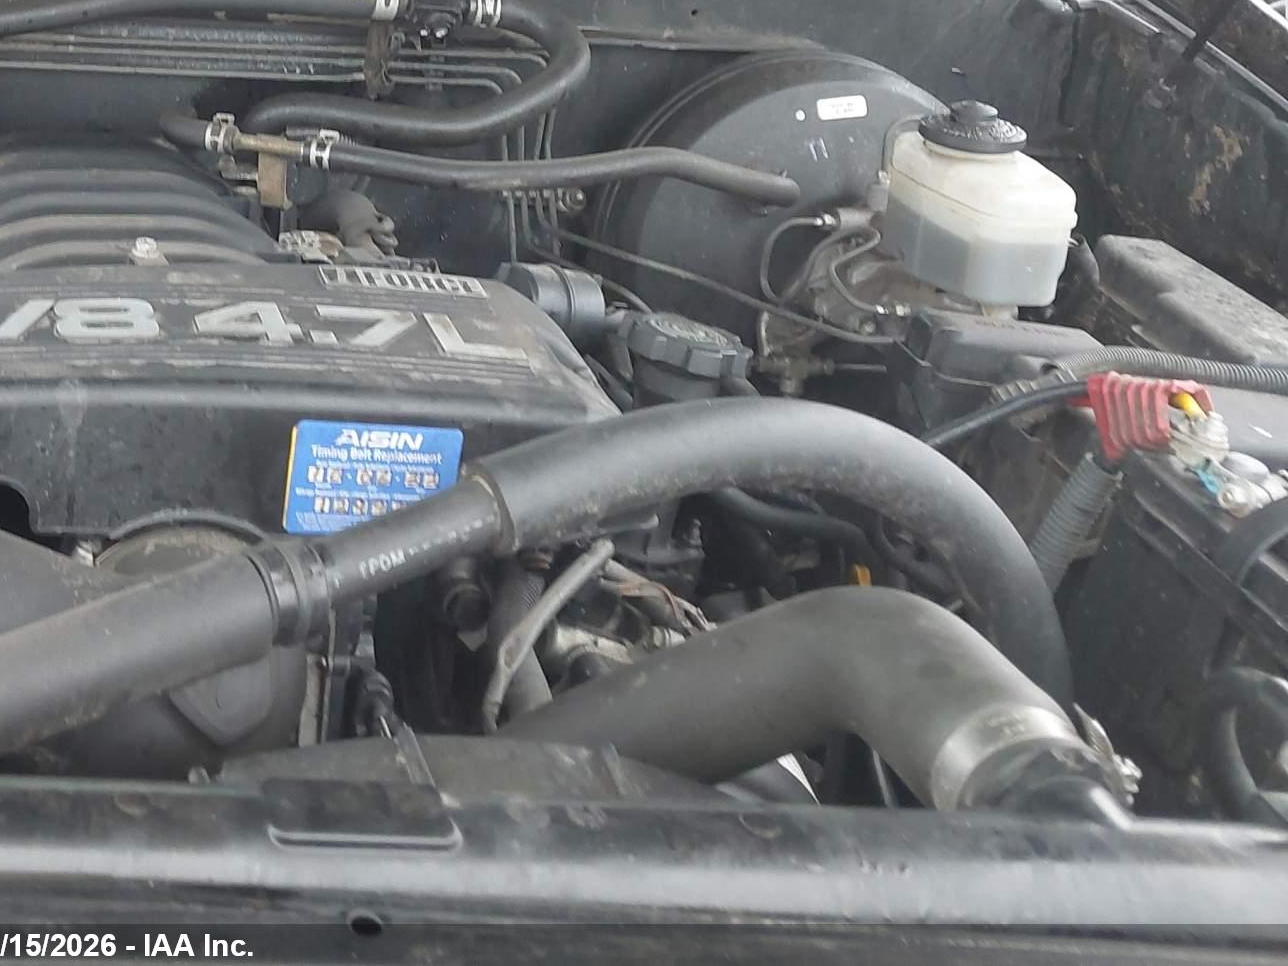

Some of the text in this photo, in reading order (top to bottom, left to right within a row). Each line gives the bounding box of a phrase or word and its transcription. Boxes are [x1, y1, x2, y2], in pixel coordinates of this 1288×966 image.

[194, 300, 528, 360] 4.7L
[334, 429, 423, 450] AISIN
[312, 444, 442, 465] Timing Belt Replacement
